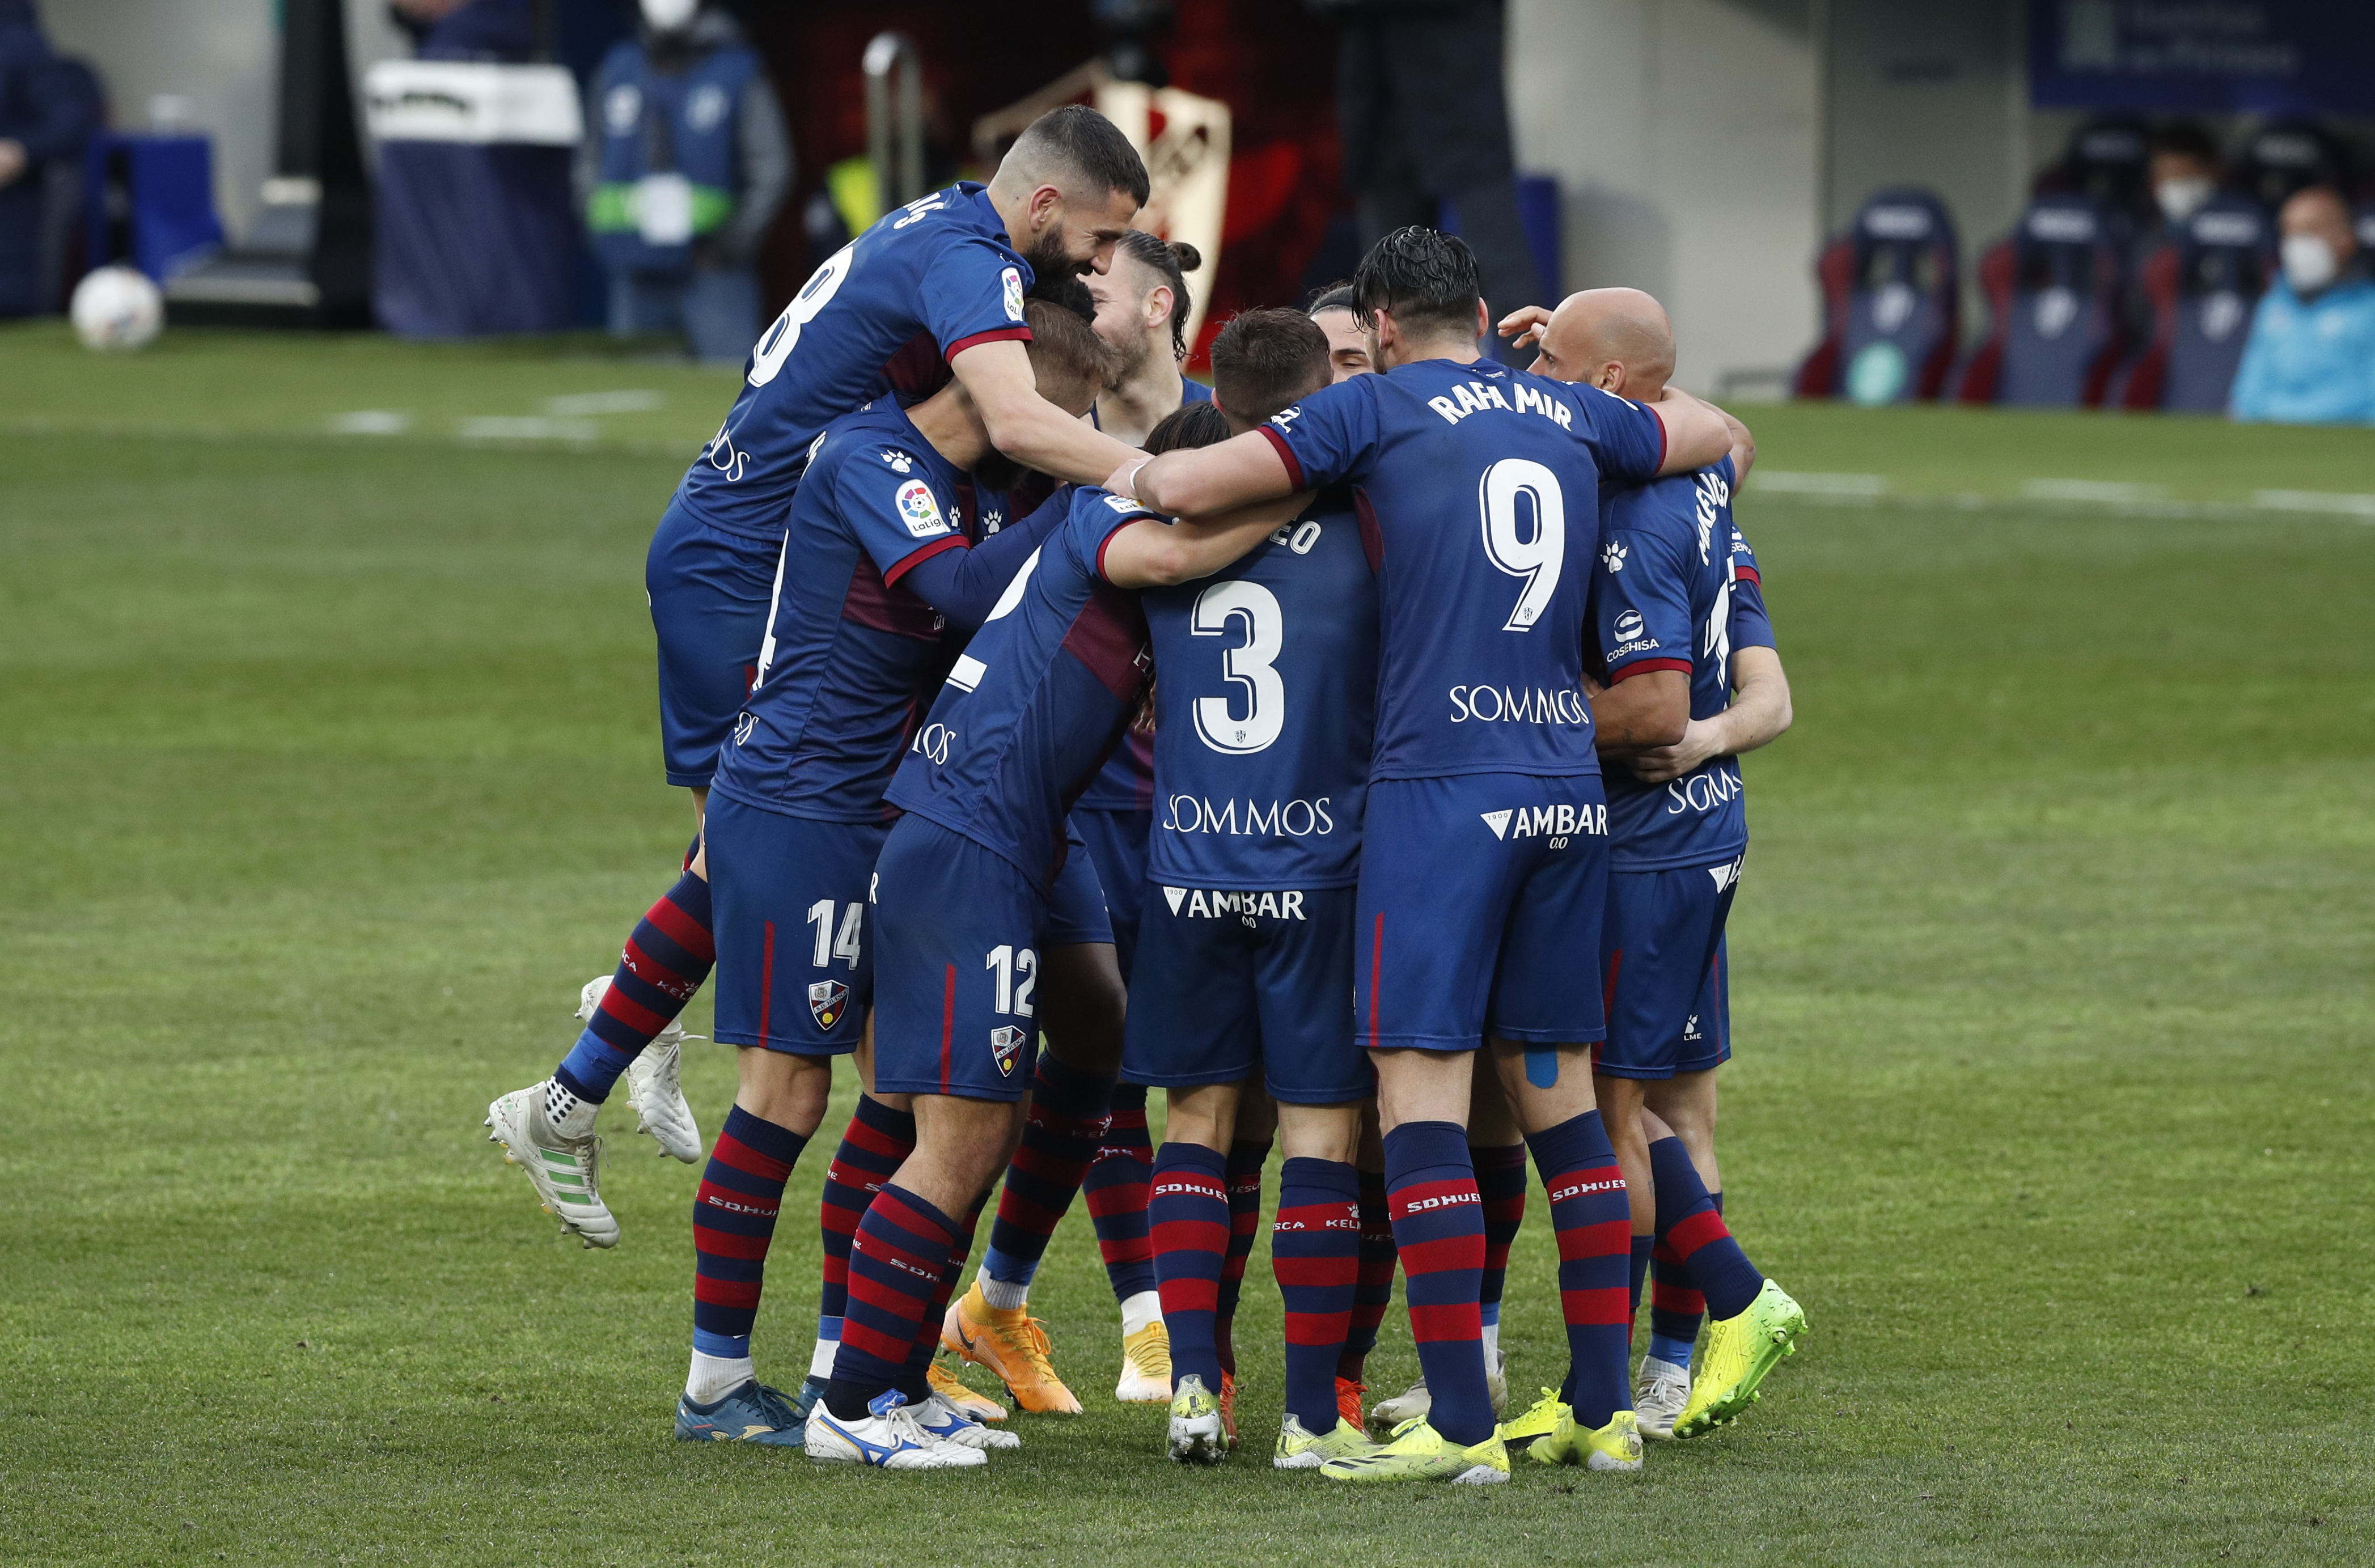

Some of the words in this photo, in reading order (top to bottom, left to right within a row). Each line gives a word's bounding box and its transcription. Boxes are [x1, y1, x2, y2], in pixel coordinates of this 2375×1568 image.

[1427, 382, 1514, 425] RAFA
[1514, 382, 1573, 432] MIR
[1479, 458, 1565, 633] 9
[1191, 580, 1285, 755] 3
[1606, 638, 1660, 663] COSEHISA
[1449, 685, 1589, 724] SOMMOS
[1163, 794, 1333, 836] SOMMOS
[1487, 812, 1509, 821] 1900
[1512, 804, 1608, 839] AMBAR
[1188, 889, 1307, 921] AMBAR
[807, 899, 863, 971] 14
[827, 990, 848, 1007] HUESCA
[987, 944, 1037, 1018] 12
[1007, 1037, 1024, 1052] HUESCA
